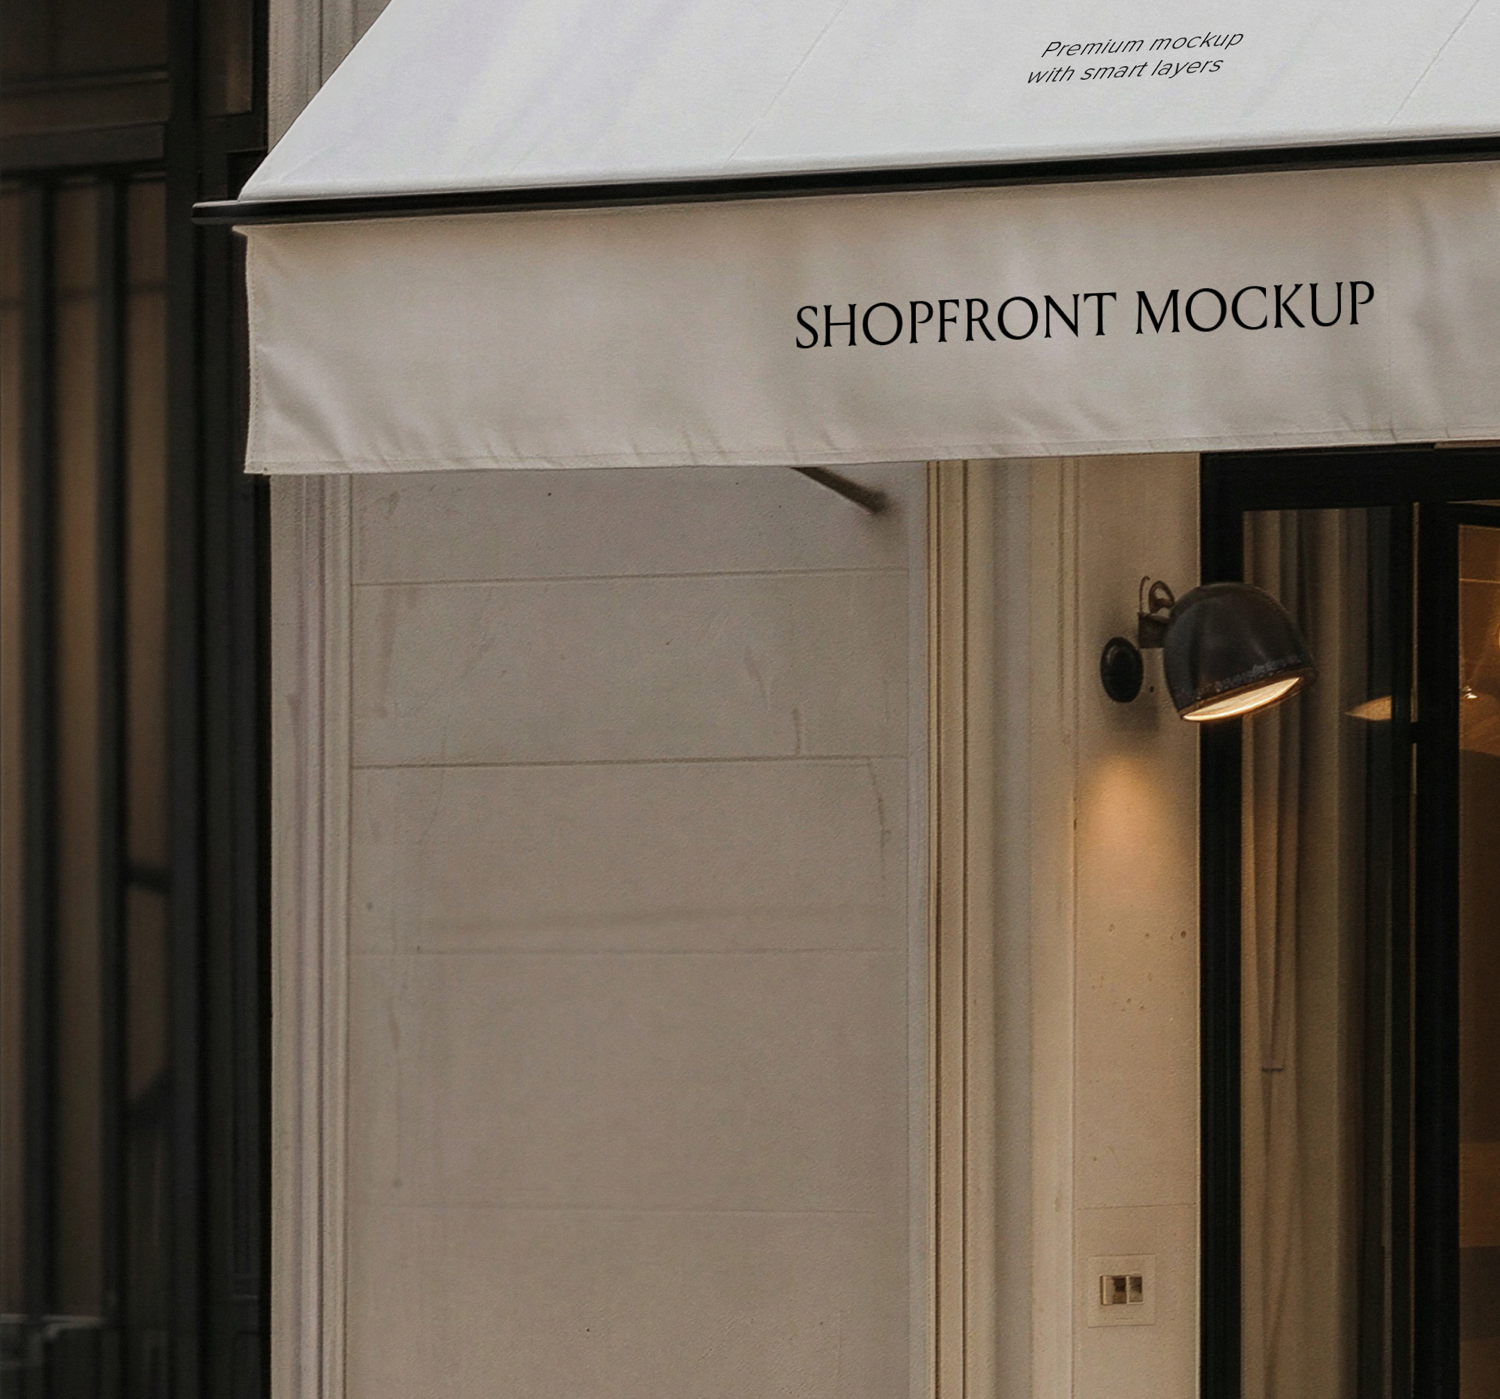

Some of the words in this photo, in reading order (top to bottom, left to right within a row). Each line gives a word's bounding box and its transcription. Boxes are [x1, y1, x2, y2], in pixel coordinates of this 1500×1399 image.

[1040, 37, 1145, 57] Premium
[1148, 31, 1244, 51] mockup
[1027, 65, 1076, 84] with
[1079, 61, 1149, 80] smart
[1150, 57, 1225, 79] layers
[795, 291, 1118, 349] SHOPFRONT
[1135, 280, 1375, 335] MOCKUP
